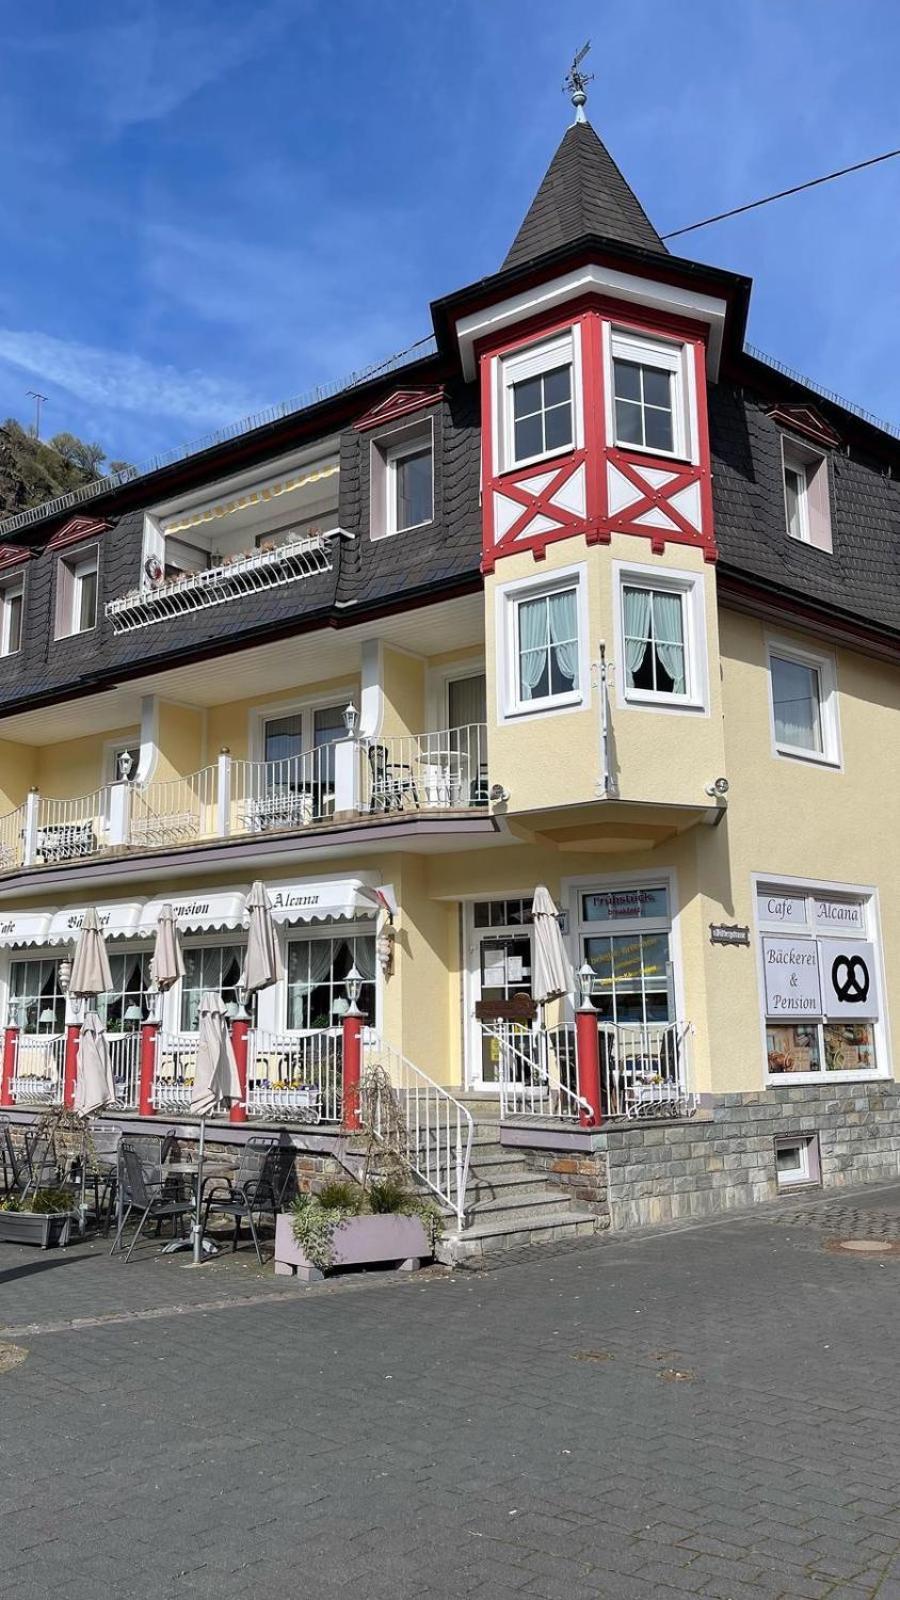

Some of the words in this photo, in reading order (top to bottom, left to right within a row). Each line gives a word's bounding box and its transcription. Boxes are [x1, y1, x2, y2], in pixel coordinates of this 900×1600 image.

[173, 902, 209, 916] ension
[273, 893, 320, 909] Alcana
[817, 903, 858, 921] Alcana
[767, 948, 816, 965] Bäckerei
[789, 972, 798, 987] &
[772, 994, 816, 1009] Pension
